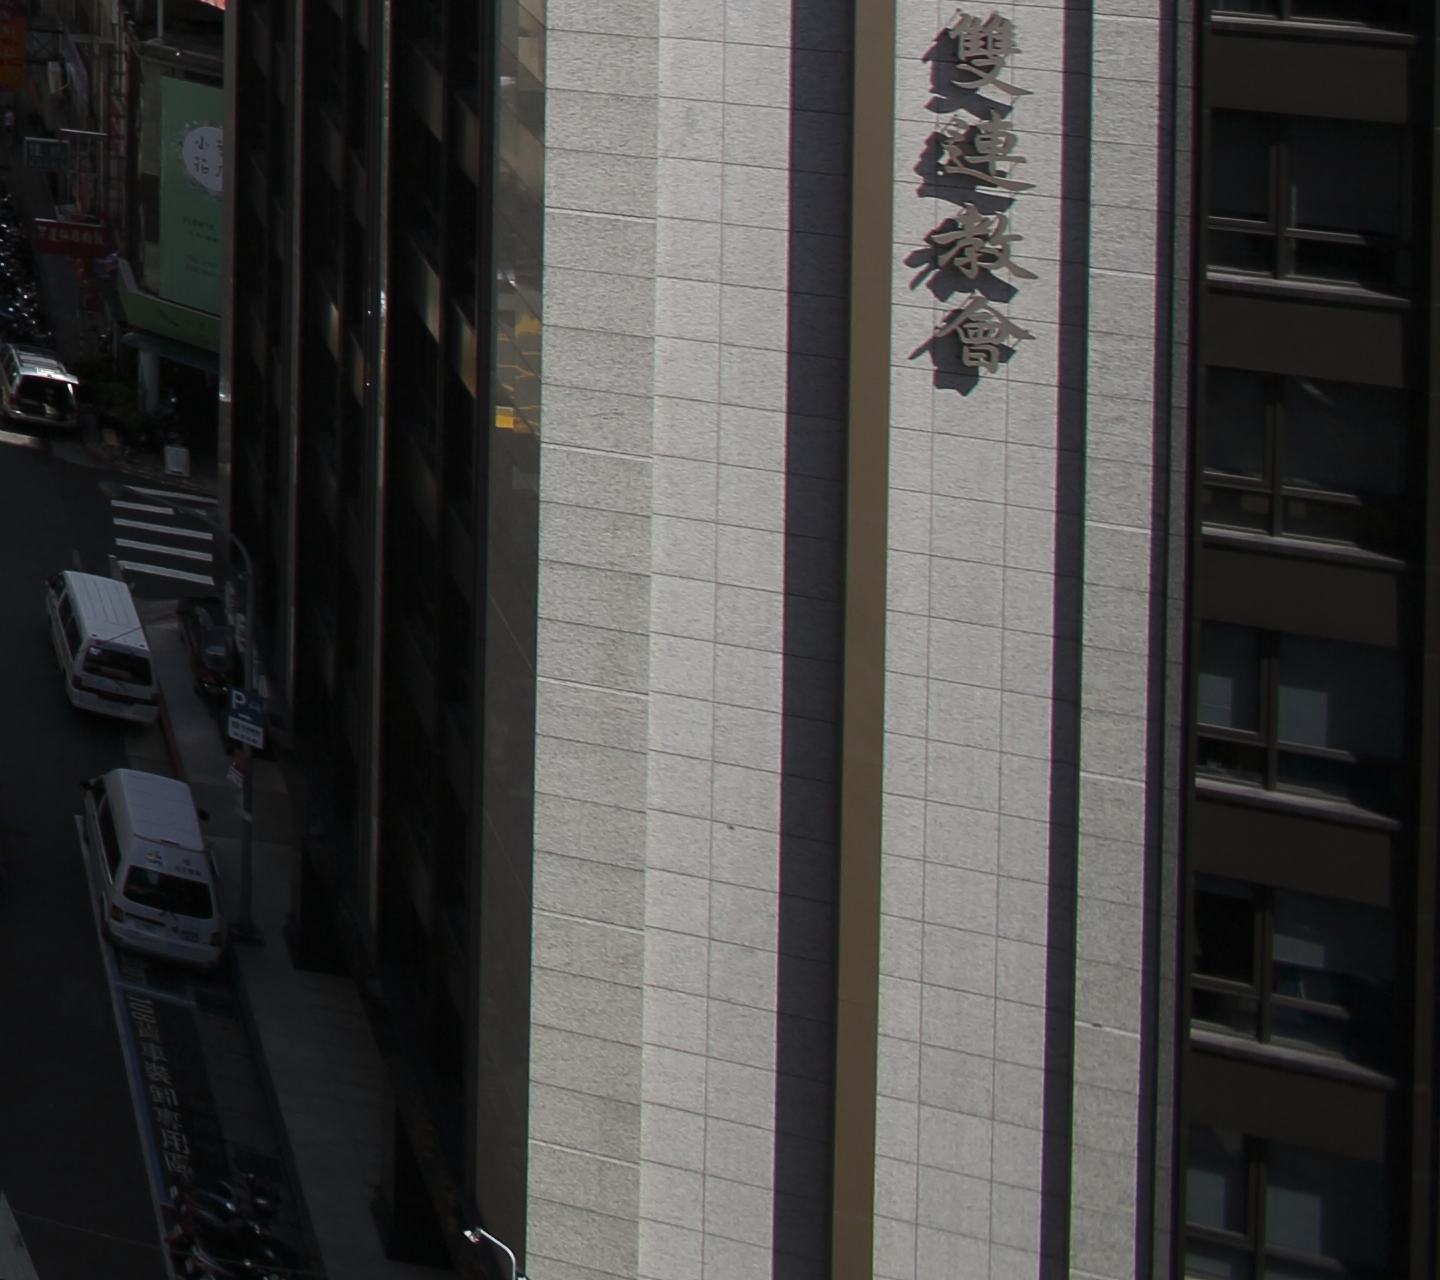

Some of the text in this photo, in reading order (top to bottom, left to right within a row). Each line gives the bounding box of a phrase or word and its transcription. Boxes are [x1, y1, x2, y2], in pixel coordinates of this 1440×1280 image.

[933, 7, 1040, 376] 雙連教會
[231, 689, 247, 709] P
